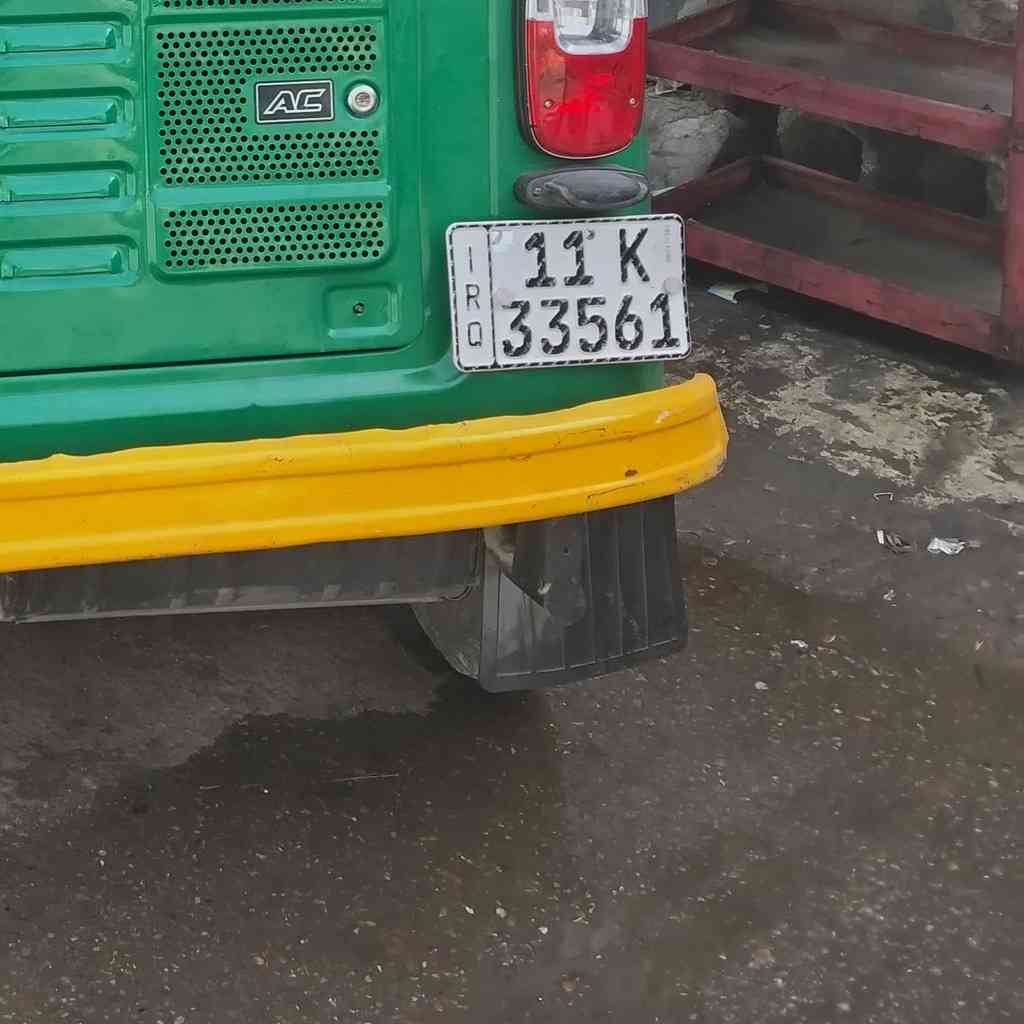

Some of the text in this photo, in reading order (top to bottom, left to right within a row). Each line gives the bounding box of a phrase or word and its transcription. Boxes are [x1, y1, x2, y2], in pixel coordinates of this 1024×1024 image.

[263, 88, 326, 115] AC
[525, 230, 595, 288] 11
[619, 227, 650, 283] K
[501, 293, 680, 357] 33561
